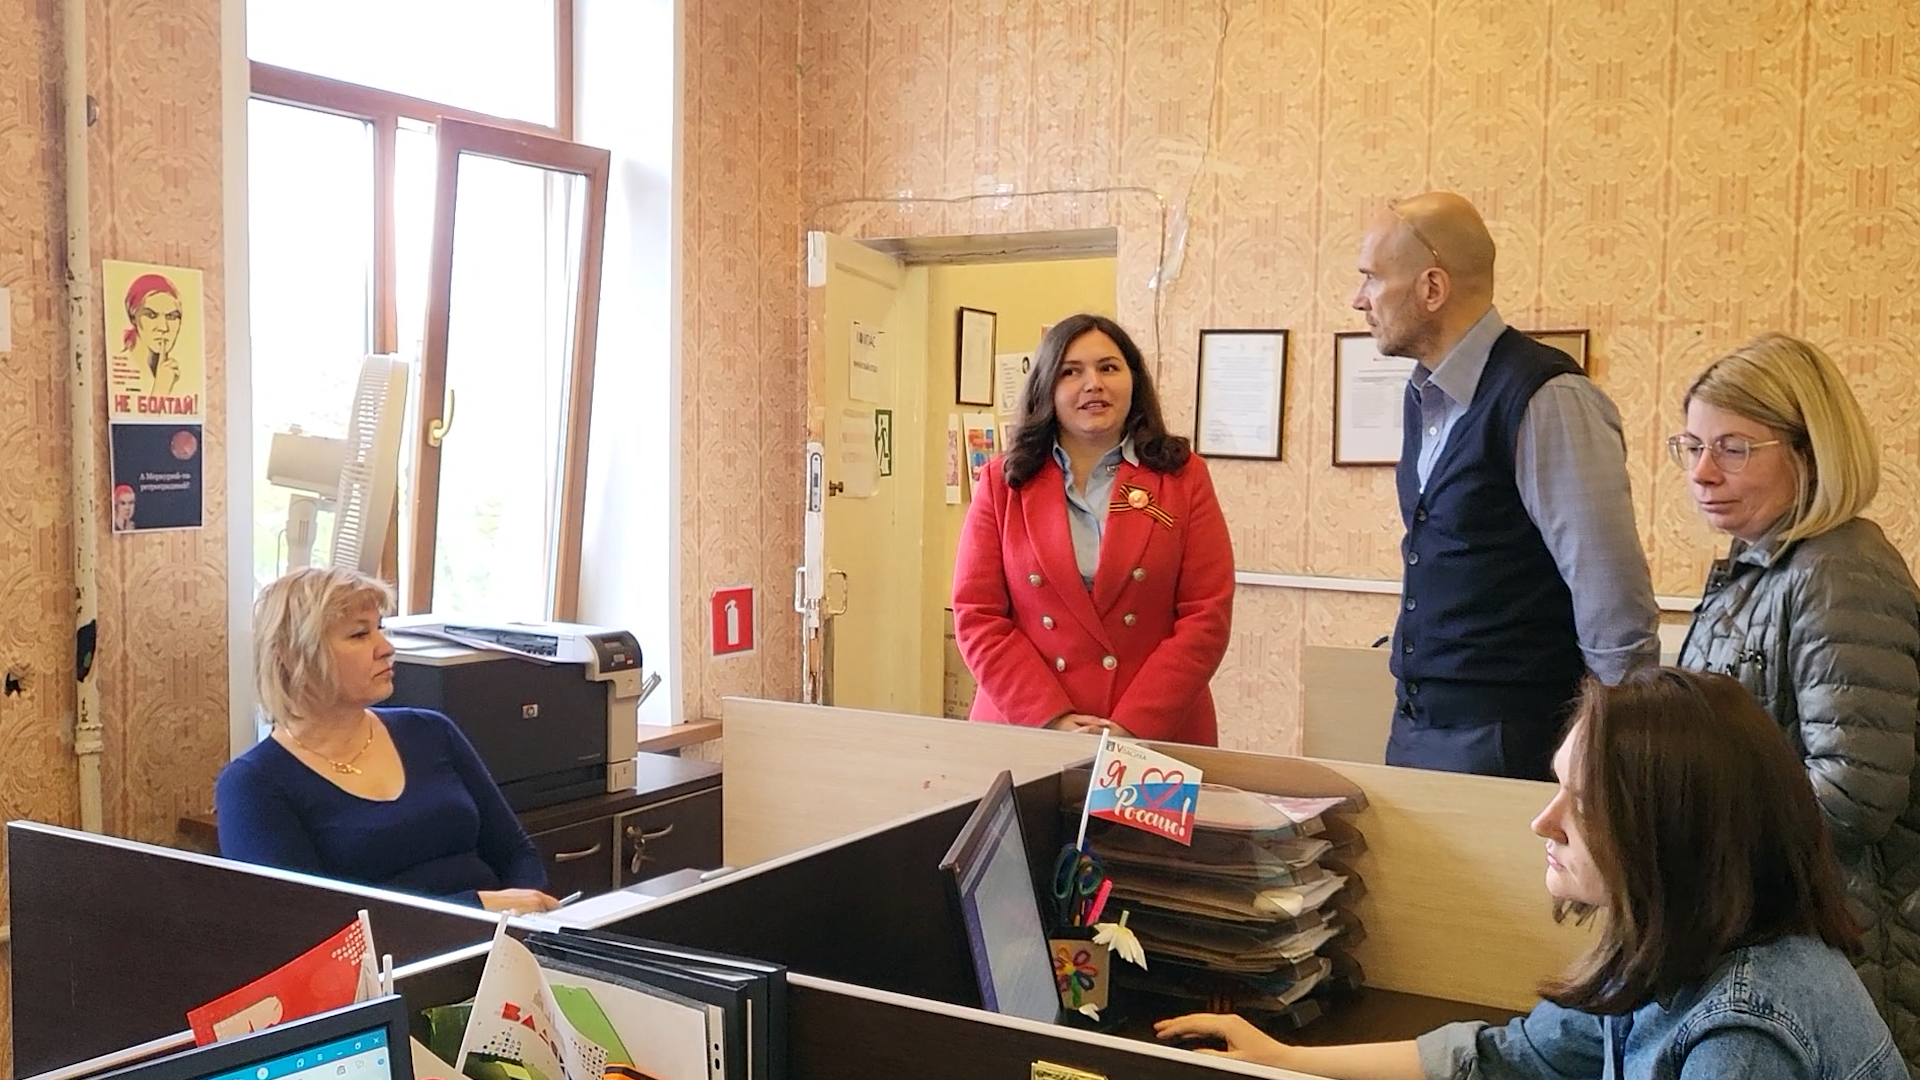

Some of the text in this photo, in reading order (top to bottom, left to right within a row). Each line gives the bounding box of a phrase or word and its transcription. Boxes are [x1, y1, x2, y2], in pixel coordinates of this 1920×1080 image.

[115, 394, 199, 415] НЕ БОЛТАЙ!
[1100, 759, 1127, 788] Я
[1114, 785, 1191, 837] Россию!
